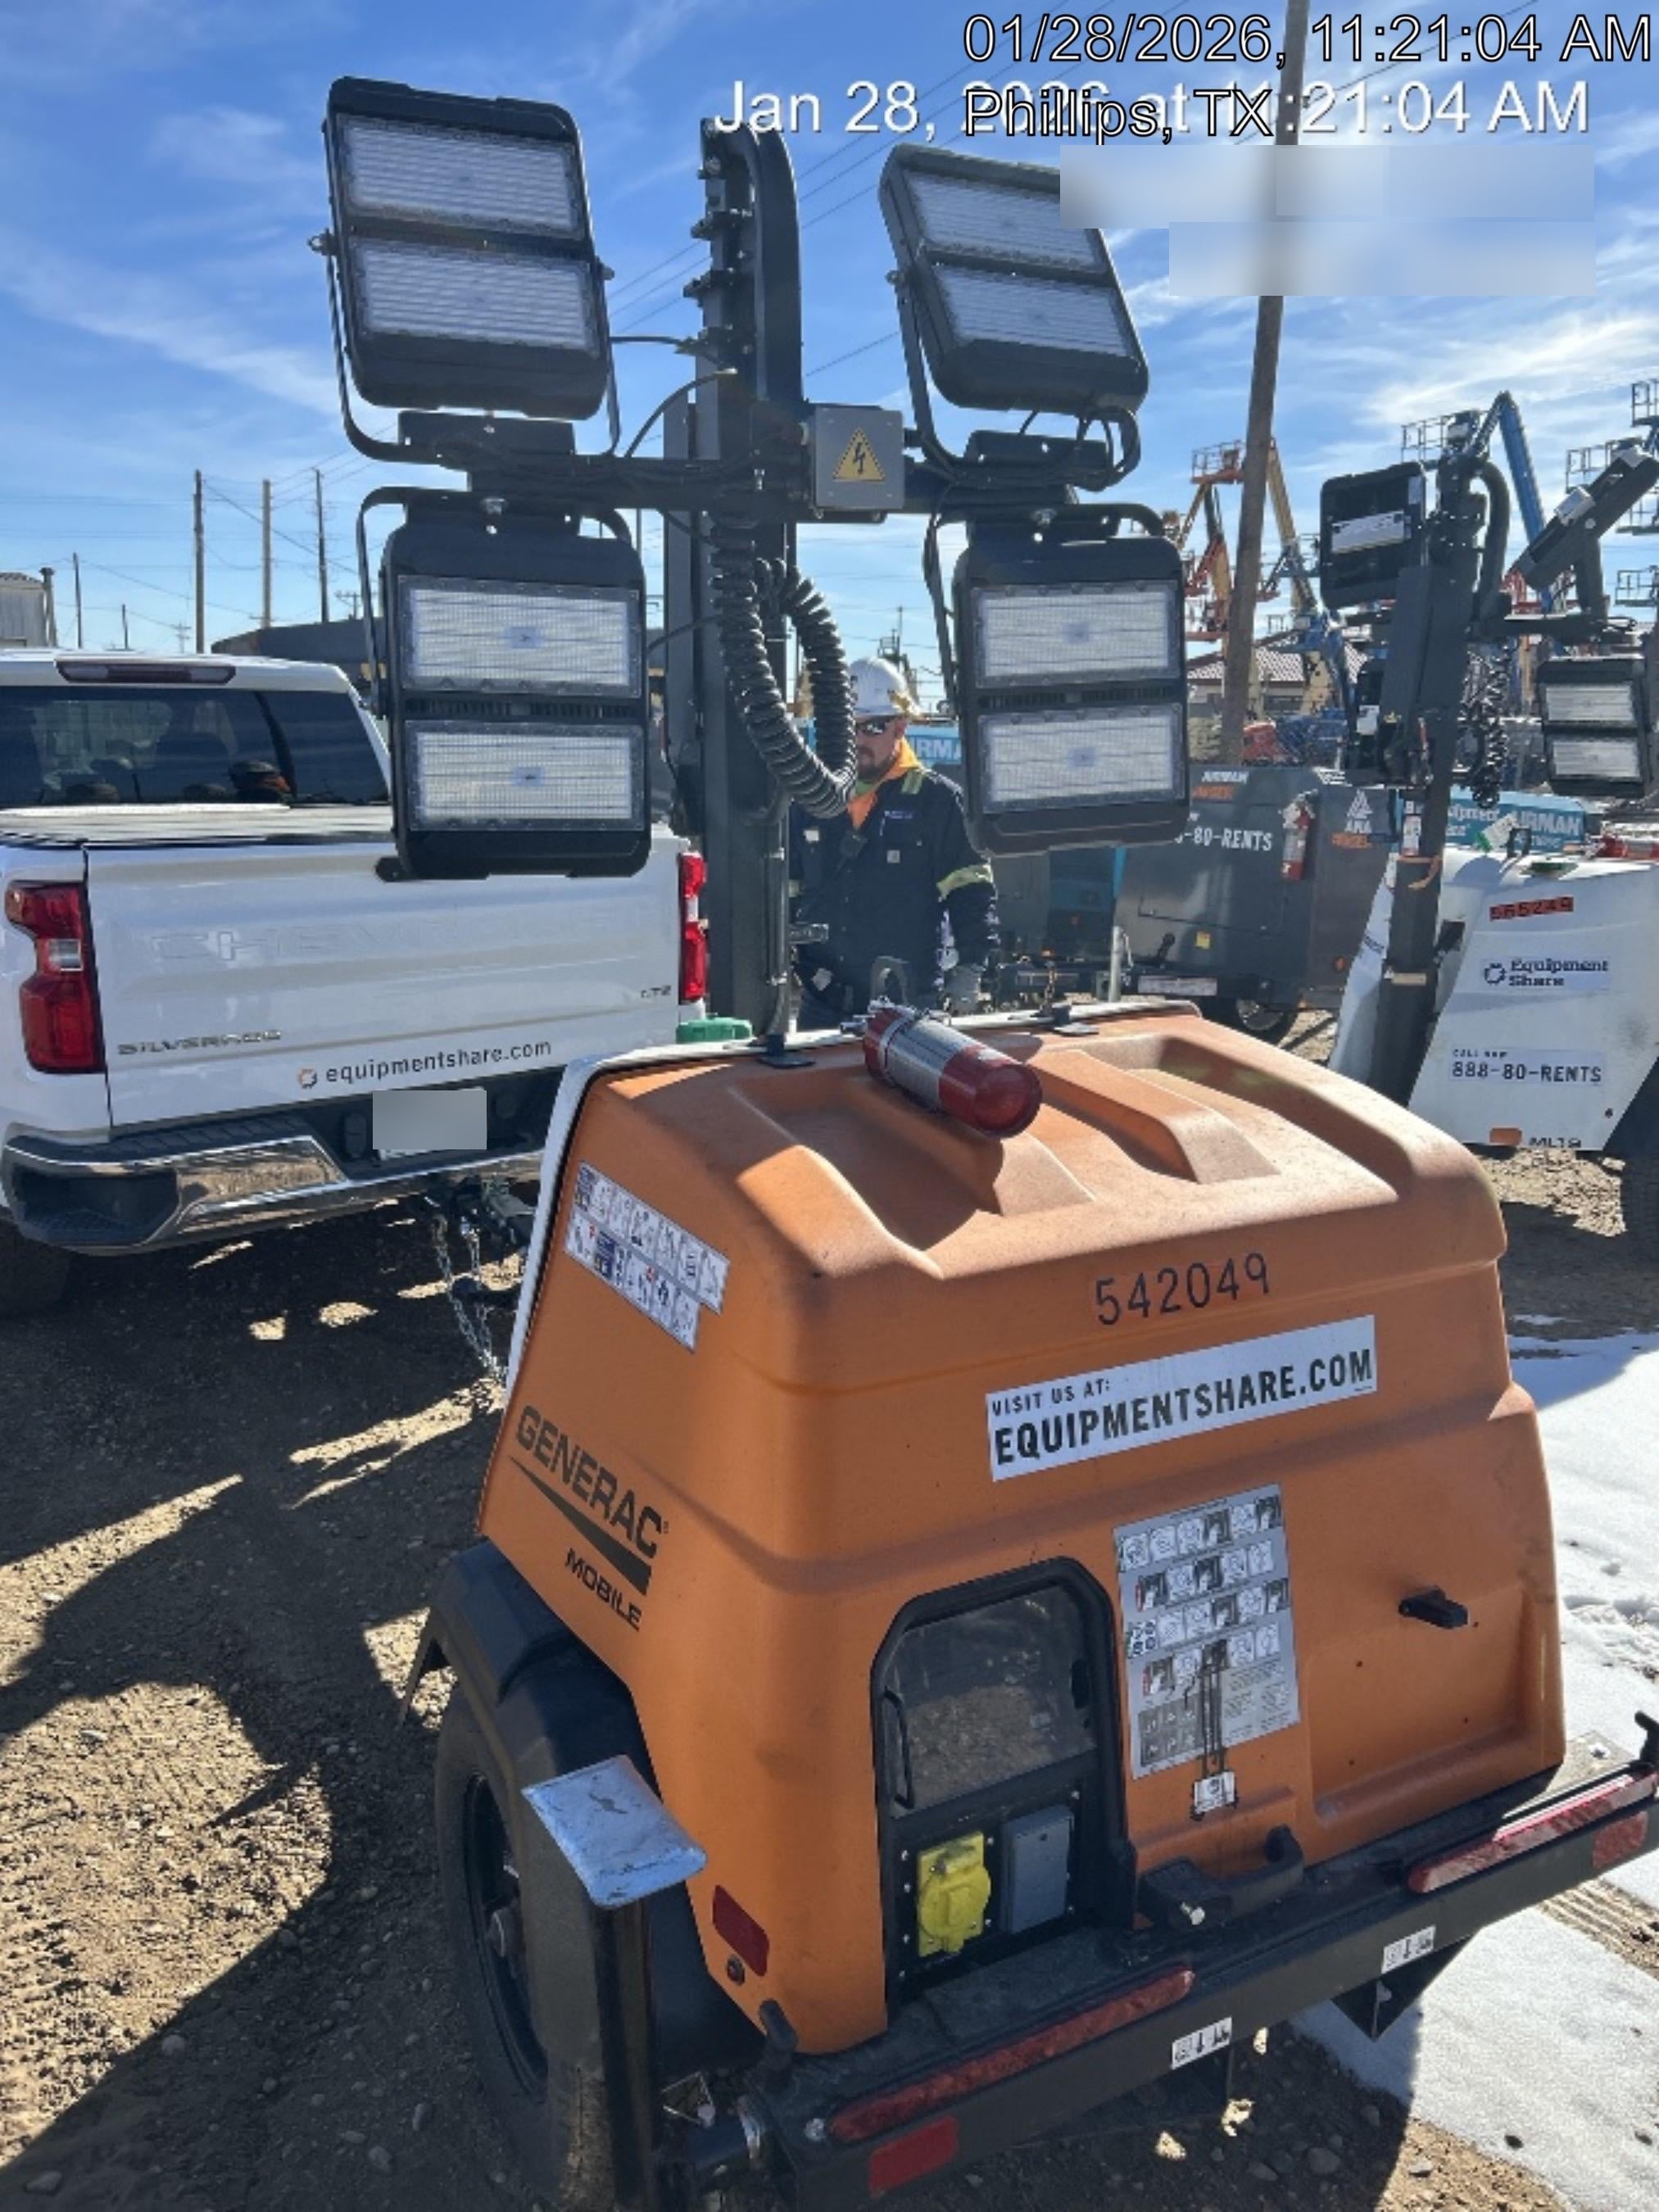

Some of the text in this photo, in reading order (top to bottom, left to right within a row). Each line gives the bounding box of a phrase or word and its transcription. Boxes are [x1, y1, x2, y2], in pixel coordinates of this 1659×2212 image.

[1173, 826, 1272, 852] -80-RENTS
[1509, 975, 1564, 986] Share
[1511, 958, 1608, 973] Equipment
[325, 1038, 551, 1084] equipmentshare.com
[1452, 1062, 1602, 1083] 888-80-RENTS
[1095, 1253, 1270, 1326] 542049
[992, 1378, 1111, 1416] VISIT US AT:
[994, 1349, 1372, 1466] EQUIPMENTSHARE.COM
[516, 1406, 663, 1558] GENERAC
[565, 1548, 642, 1631] MOBILE
